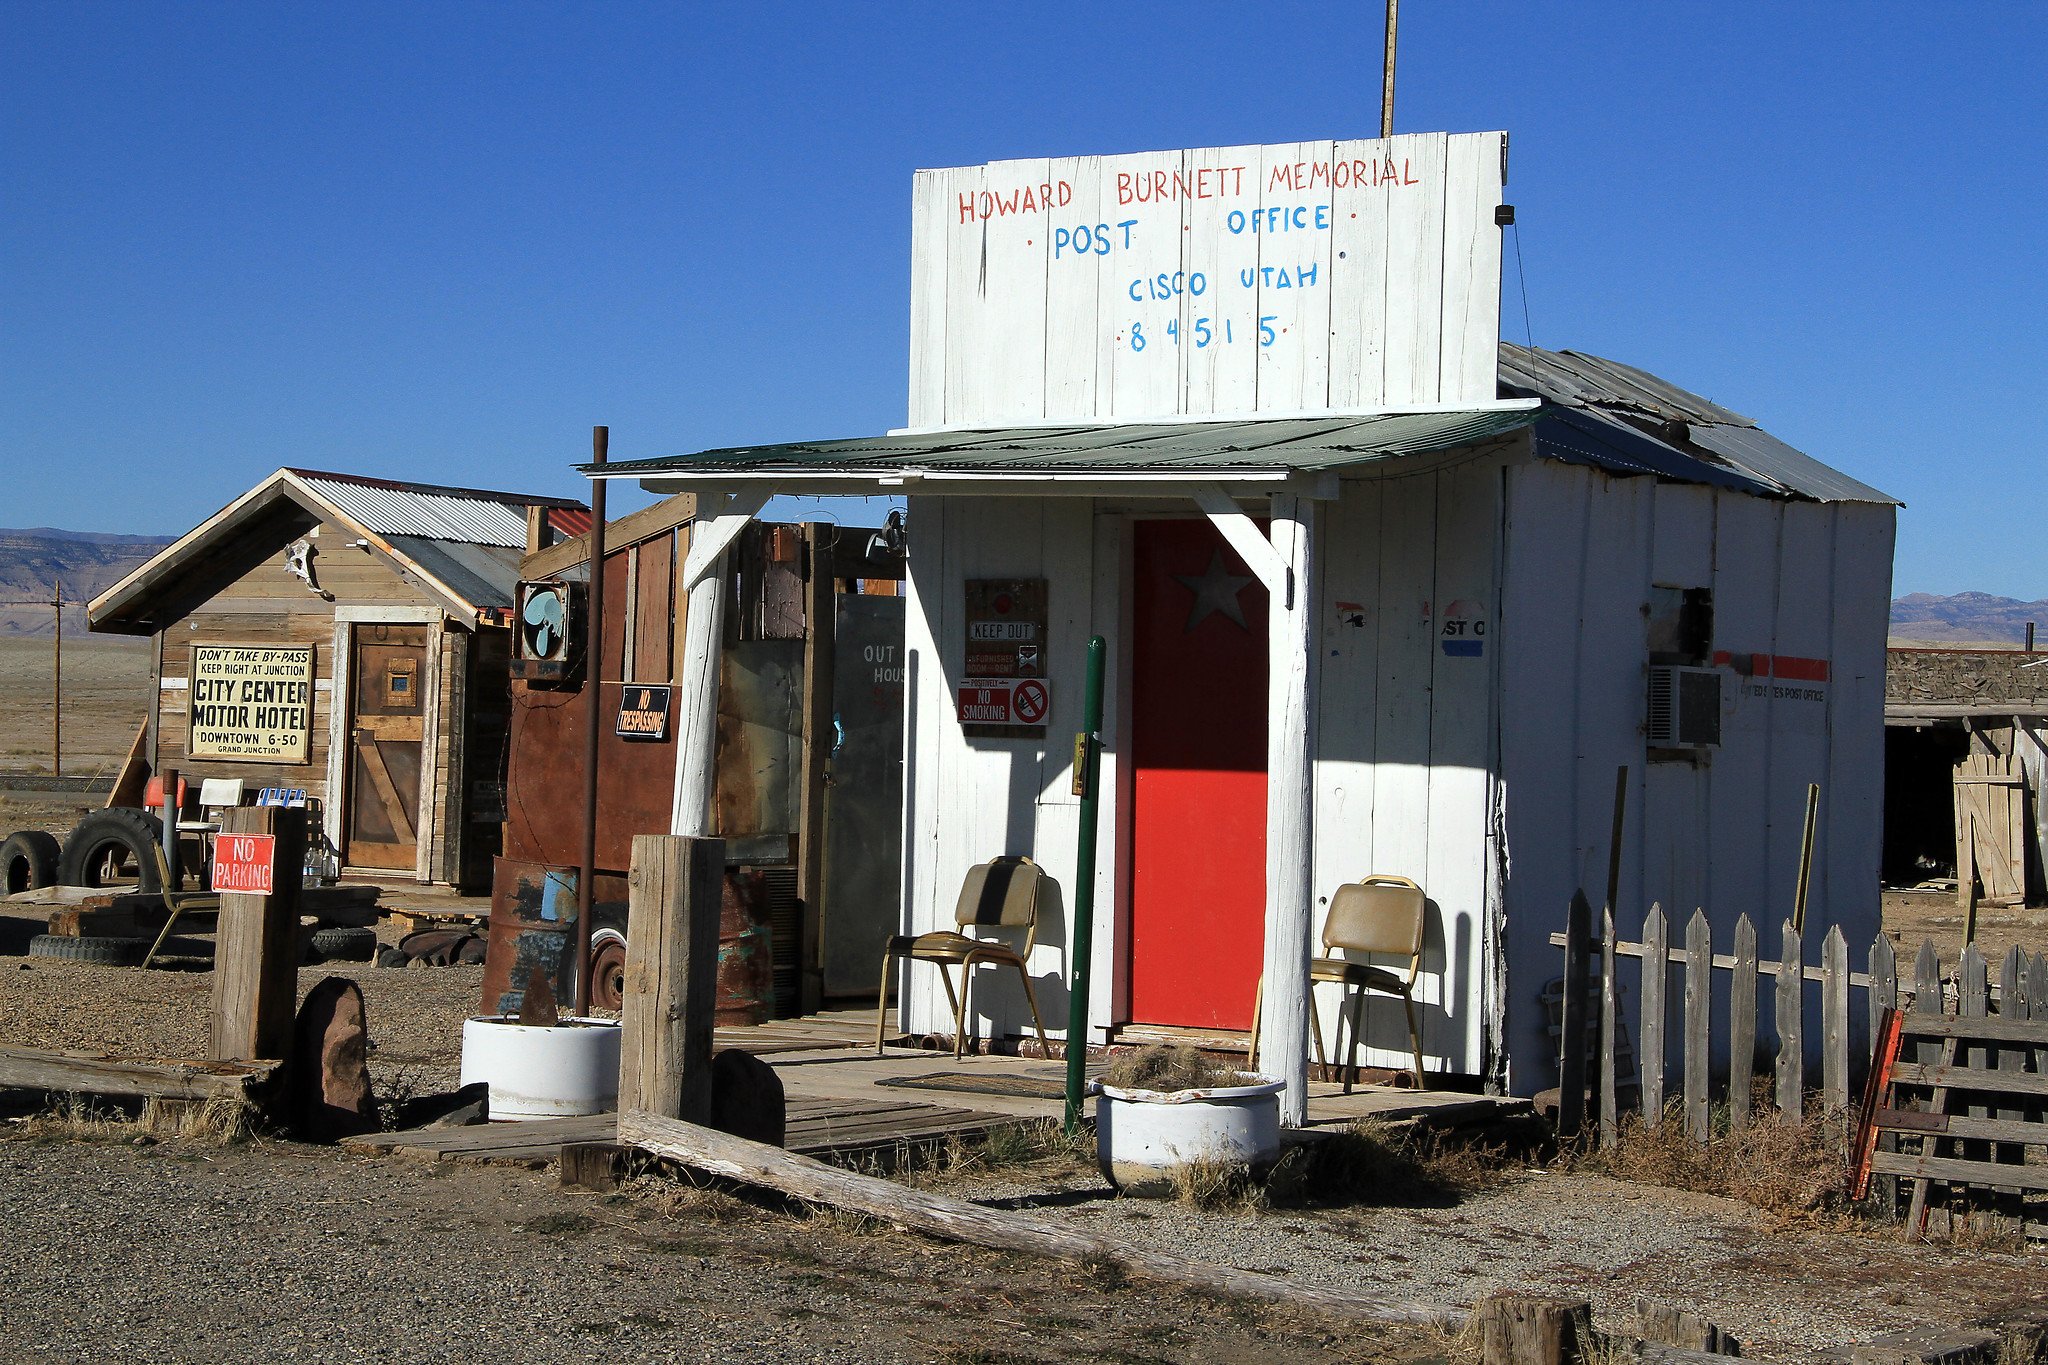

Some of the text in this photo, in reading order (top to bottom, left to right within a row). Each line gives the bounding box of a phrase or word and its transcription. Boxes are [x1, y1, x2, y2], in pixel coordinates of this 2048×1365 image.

[958, 158, 1420, 223] HOWARD BURNETT MEMORIAL
[1055, 205, 1330, 258] POST OFFICE
[1129, 263, 1318, 301] CISCO UTAH
[974, 624, 1030, 638] KEEP OUT
[199, 650, 308, 663] DON'T TAKE BY-PASS
[863, 645, 895, 663] OUT
[201, 663, 305, 676] KEEP RIGHT AT JUNCTION
[874, 667, 905, 683] HOUS
[195, 679, 308, 704] CITY CENTER
[637, 690, 651, 710] NO
[978, 689, 991, 704] NO
[1785, 688, 1802, 700] POST
[193, 705, 306, 730] MOTOR HOTEL
[619, 710, 664, 732] TRESPASSING
[963, 705, 1005, 720] SMOKING
[200, 732, 298, 746] DOWNTOWN 6-50
[233, 838, 255, 862] NO
[216, 862, 270, 888] PARKING
